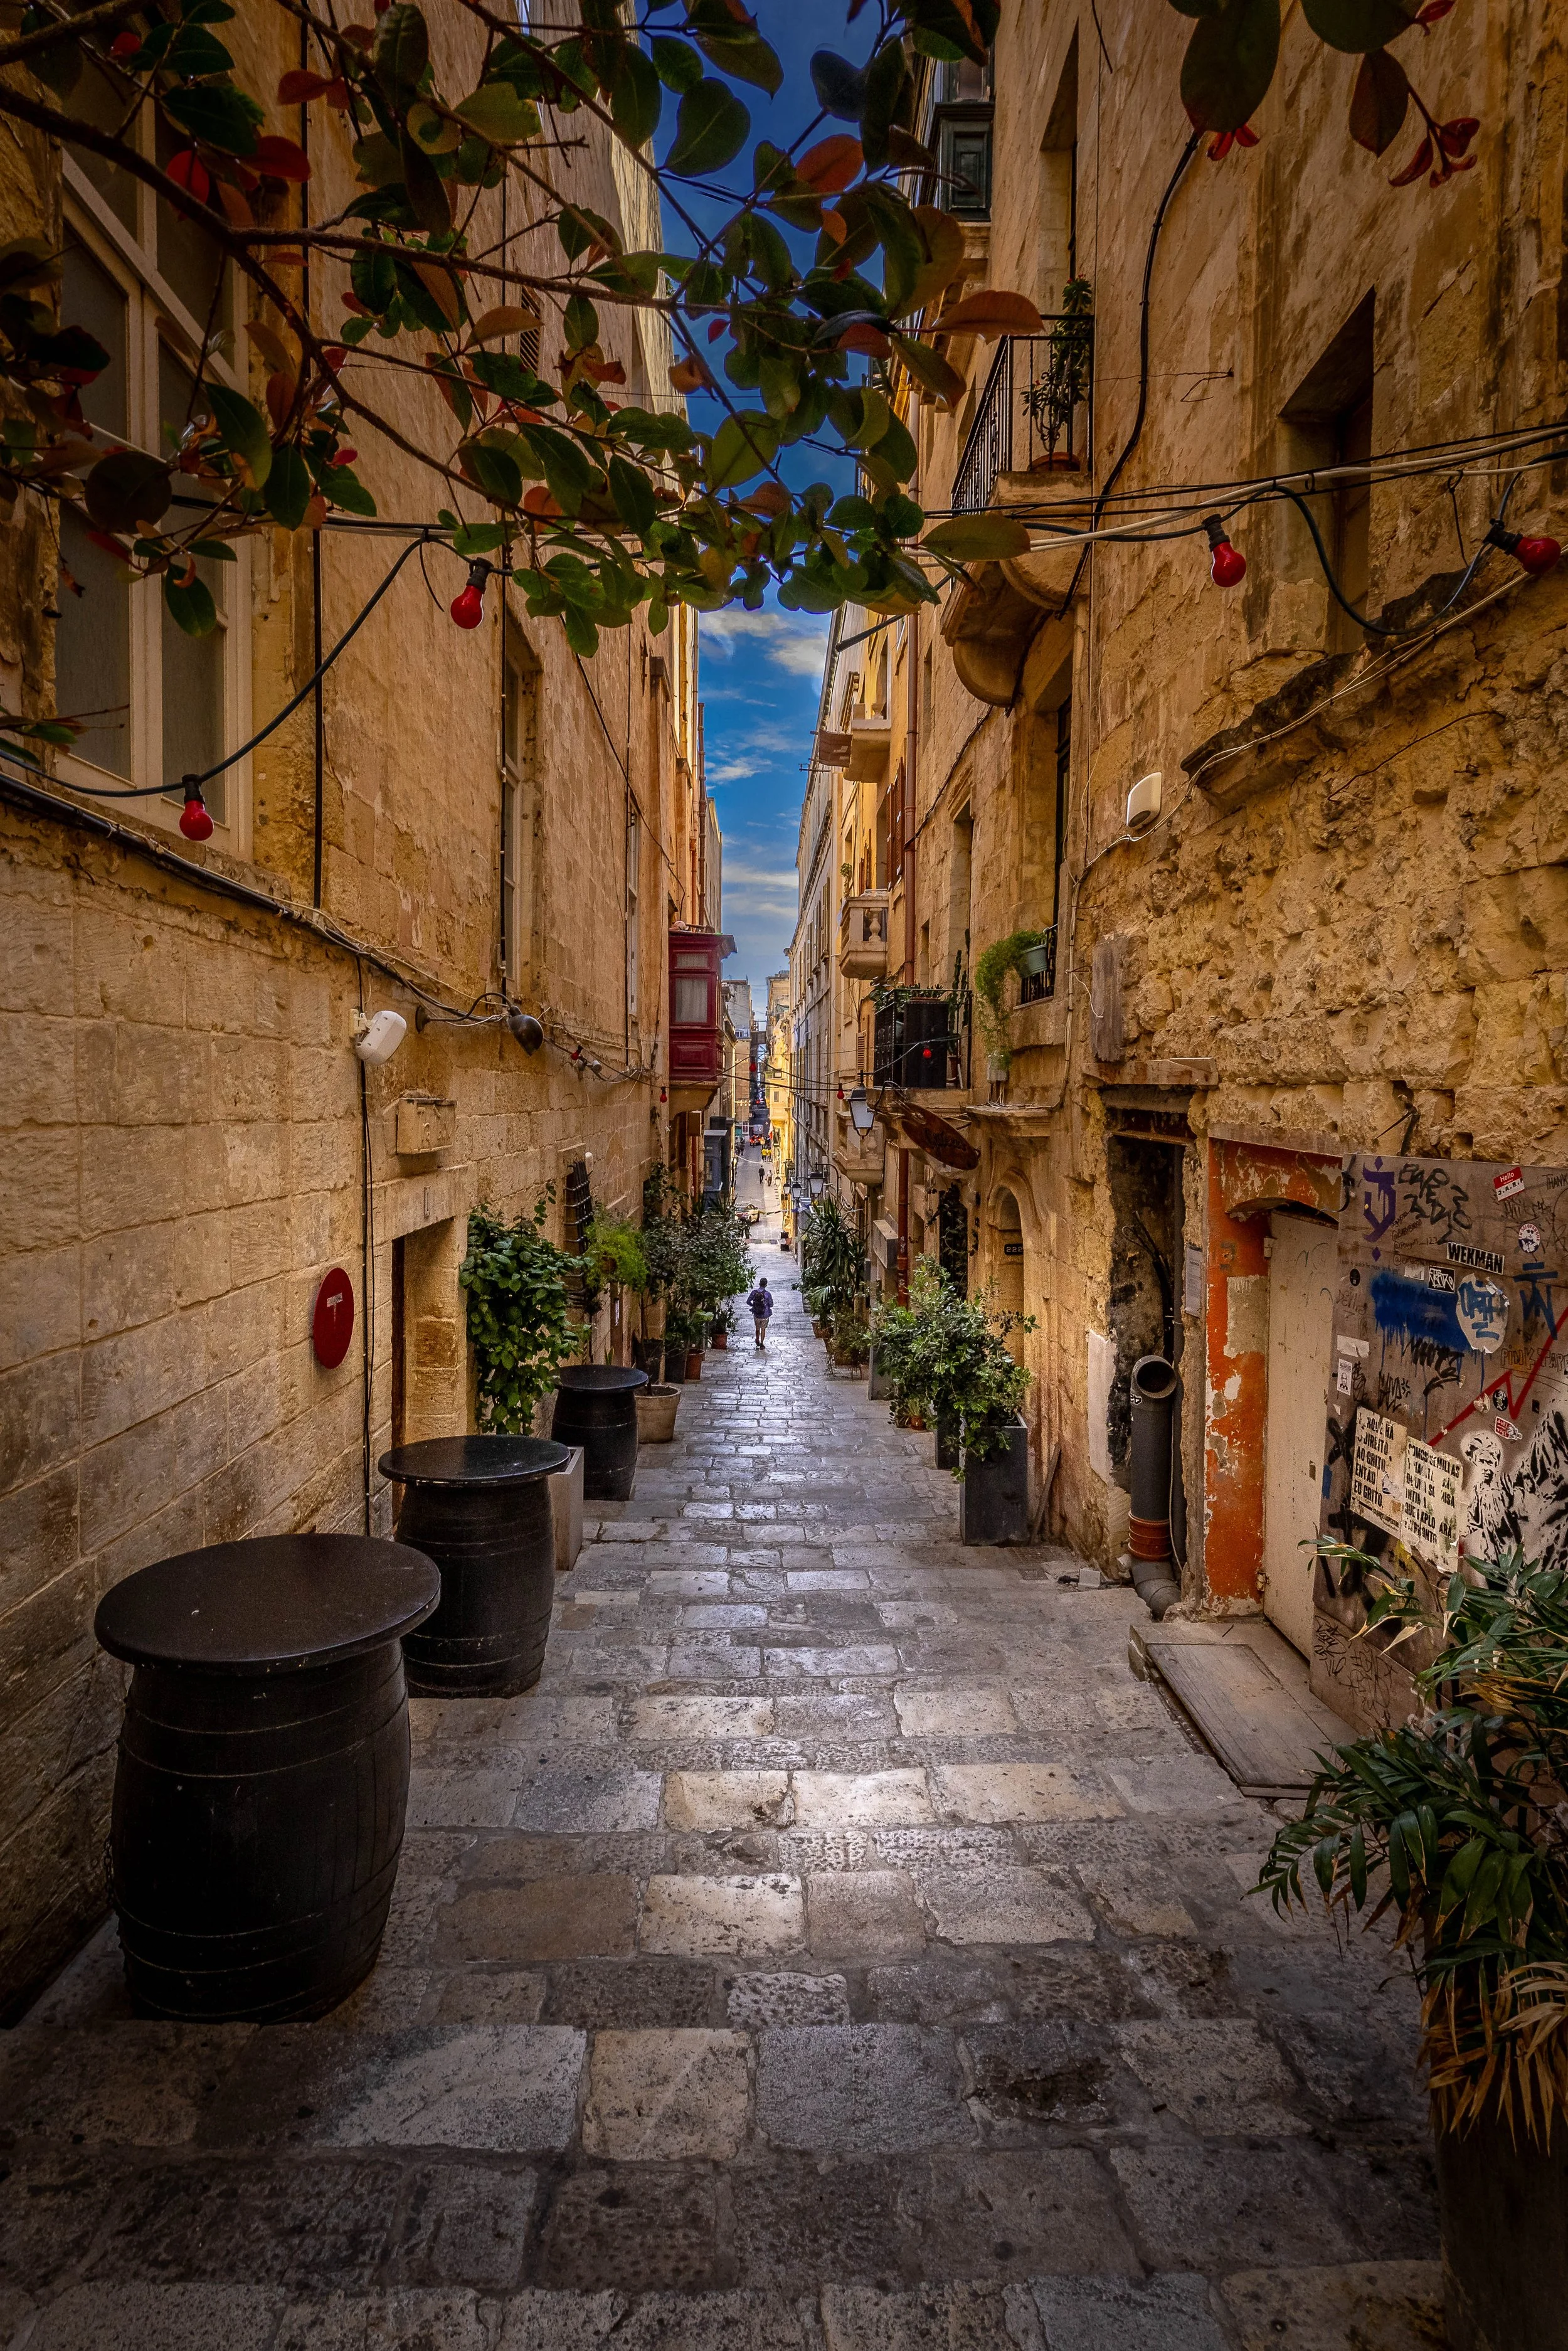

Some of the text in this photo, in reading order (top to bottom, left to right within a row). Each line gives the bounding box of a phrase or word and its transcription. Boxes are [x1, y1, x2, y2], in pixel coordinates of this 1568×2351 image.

[1500, 1172, 1515, 1182] Hello
[1356, 1445, 1365, 1462] AO
[1353, 1478, 1362, 1495] EU
